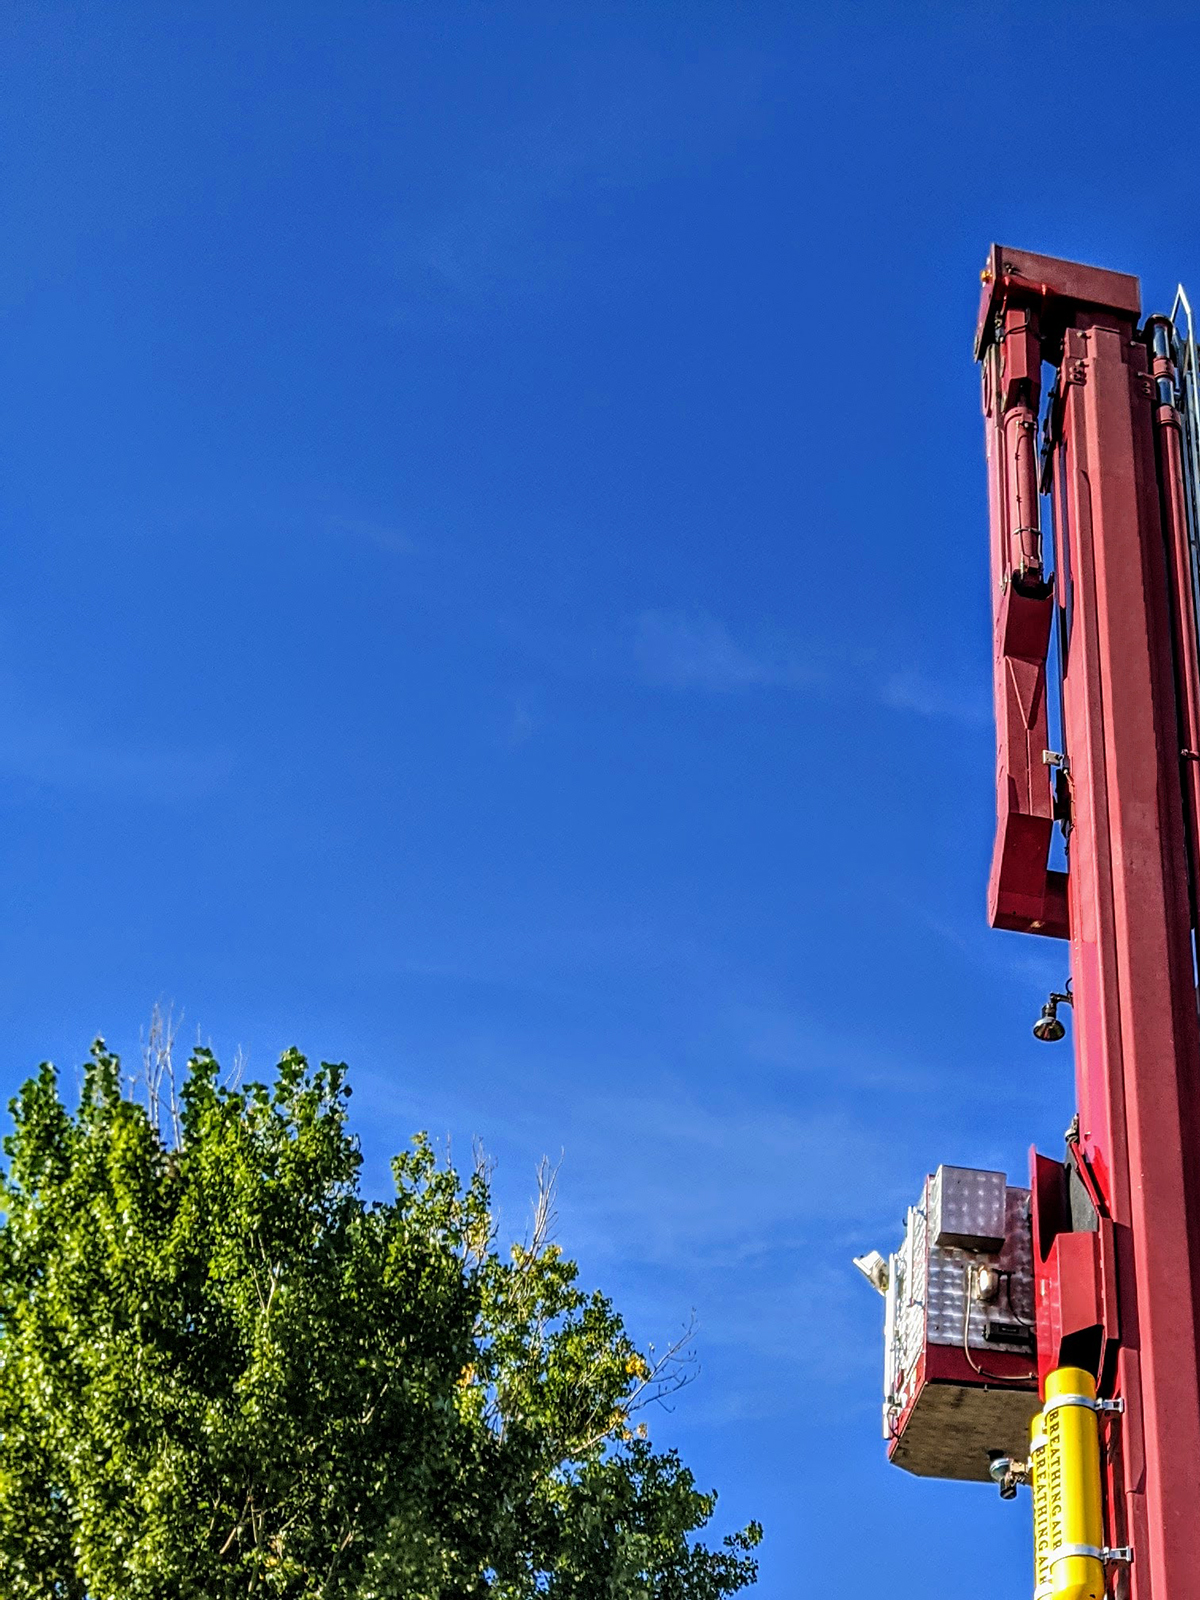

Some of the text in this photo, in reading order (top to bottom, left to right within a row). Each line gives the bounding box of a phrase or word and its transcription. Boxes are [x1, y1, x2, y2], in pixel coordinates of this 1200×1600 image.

[1036, 1444, 1049, 1552] BREATHING
[1049, 1409, 1063, 1551] BREATHING AIR
